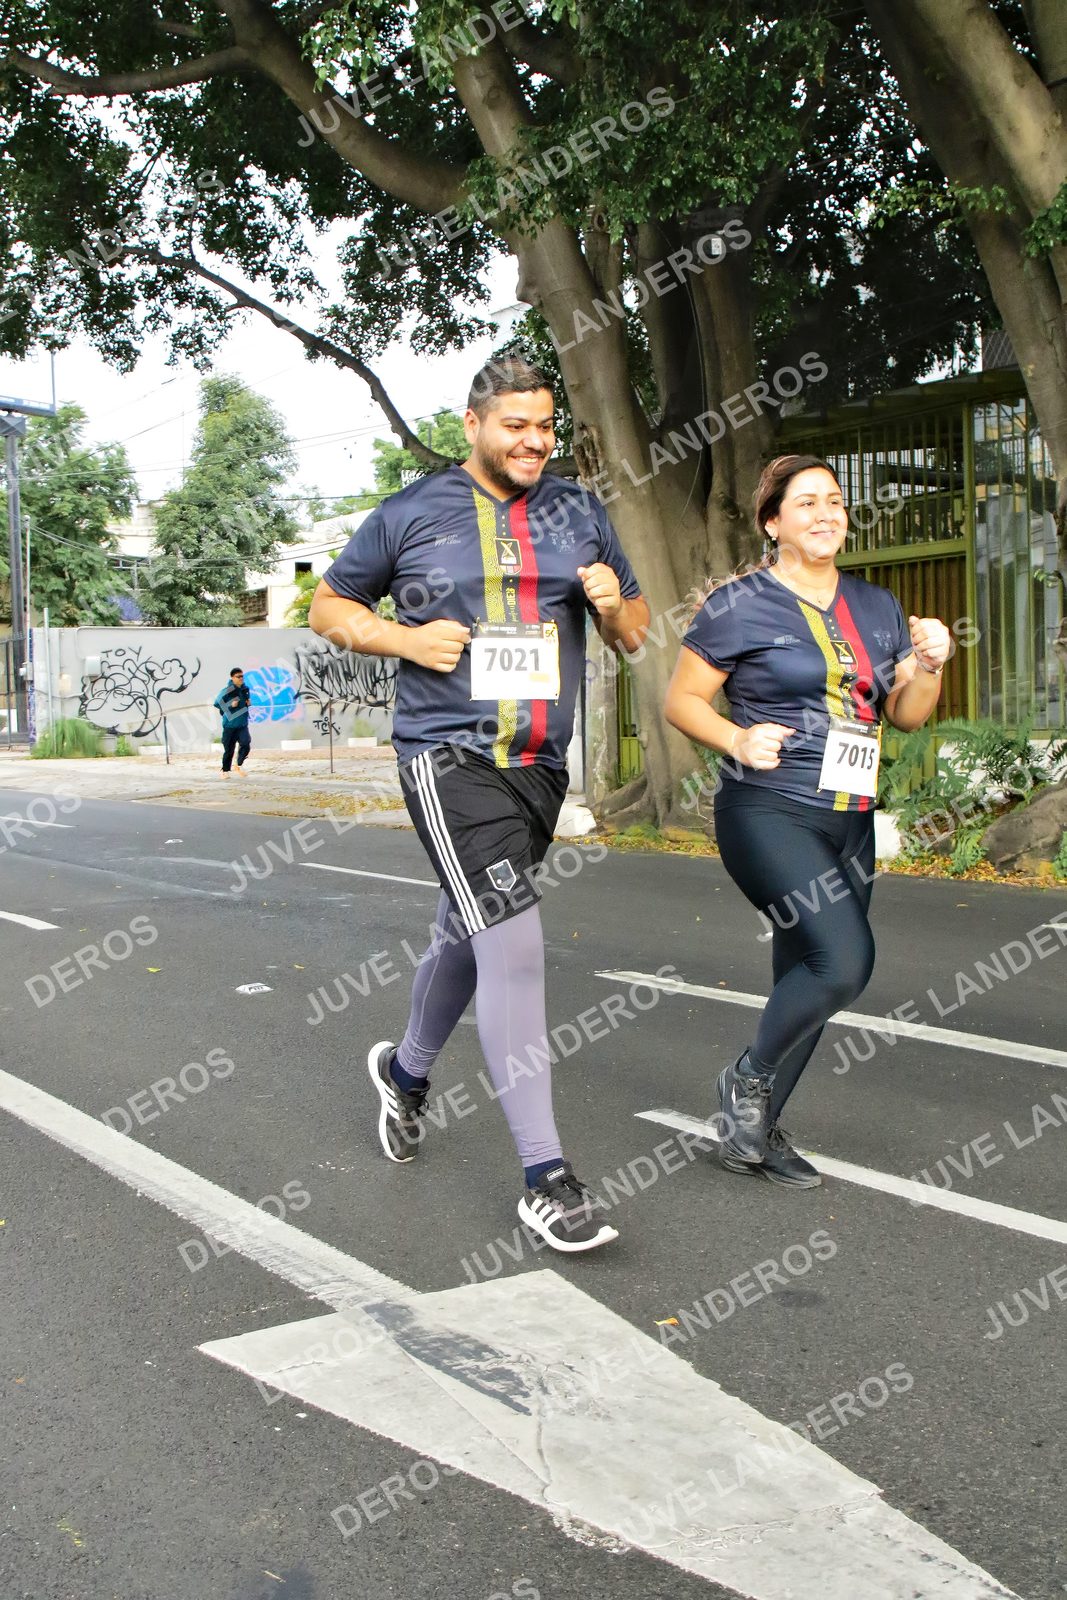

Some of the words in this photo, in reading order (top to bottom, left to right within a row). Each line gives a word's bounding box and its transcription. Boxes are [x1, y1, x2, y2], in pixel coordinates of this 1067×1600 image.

[101, 646, 142, 661] TOY
[484, 648, 540, 671] 7021
[837, 742, 875, 770] 7015
